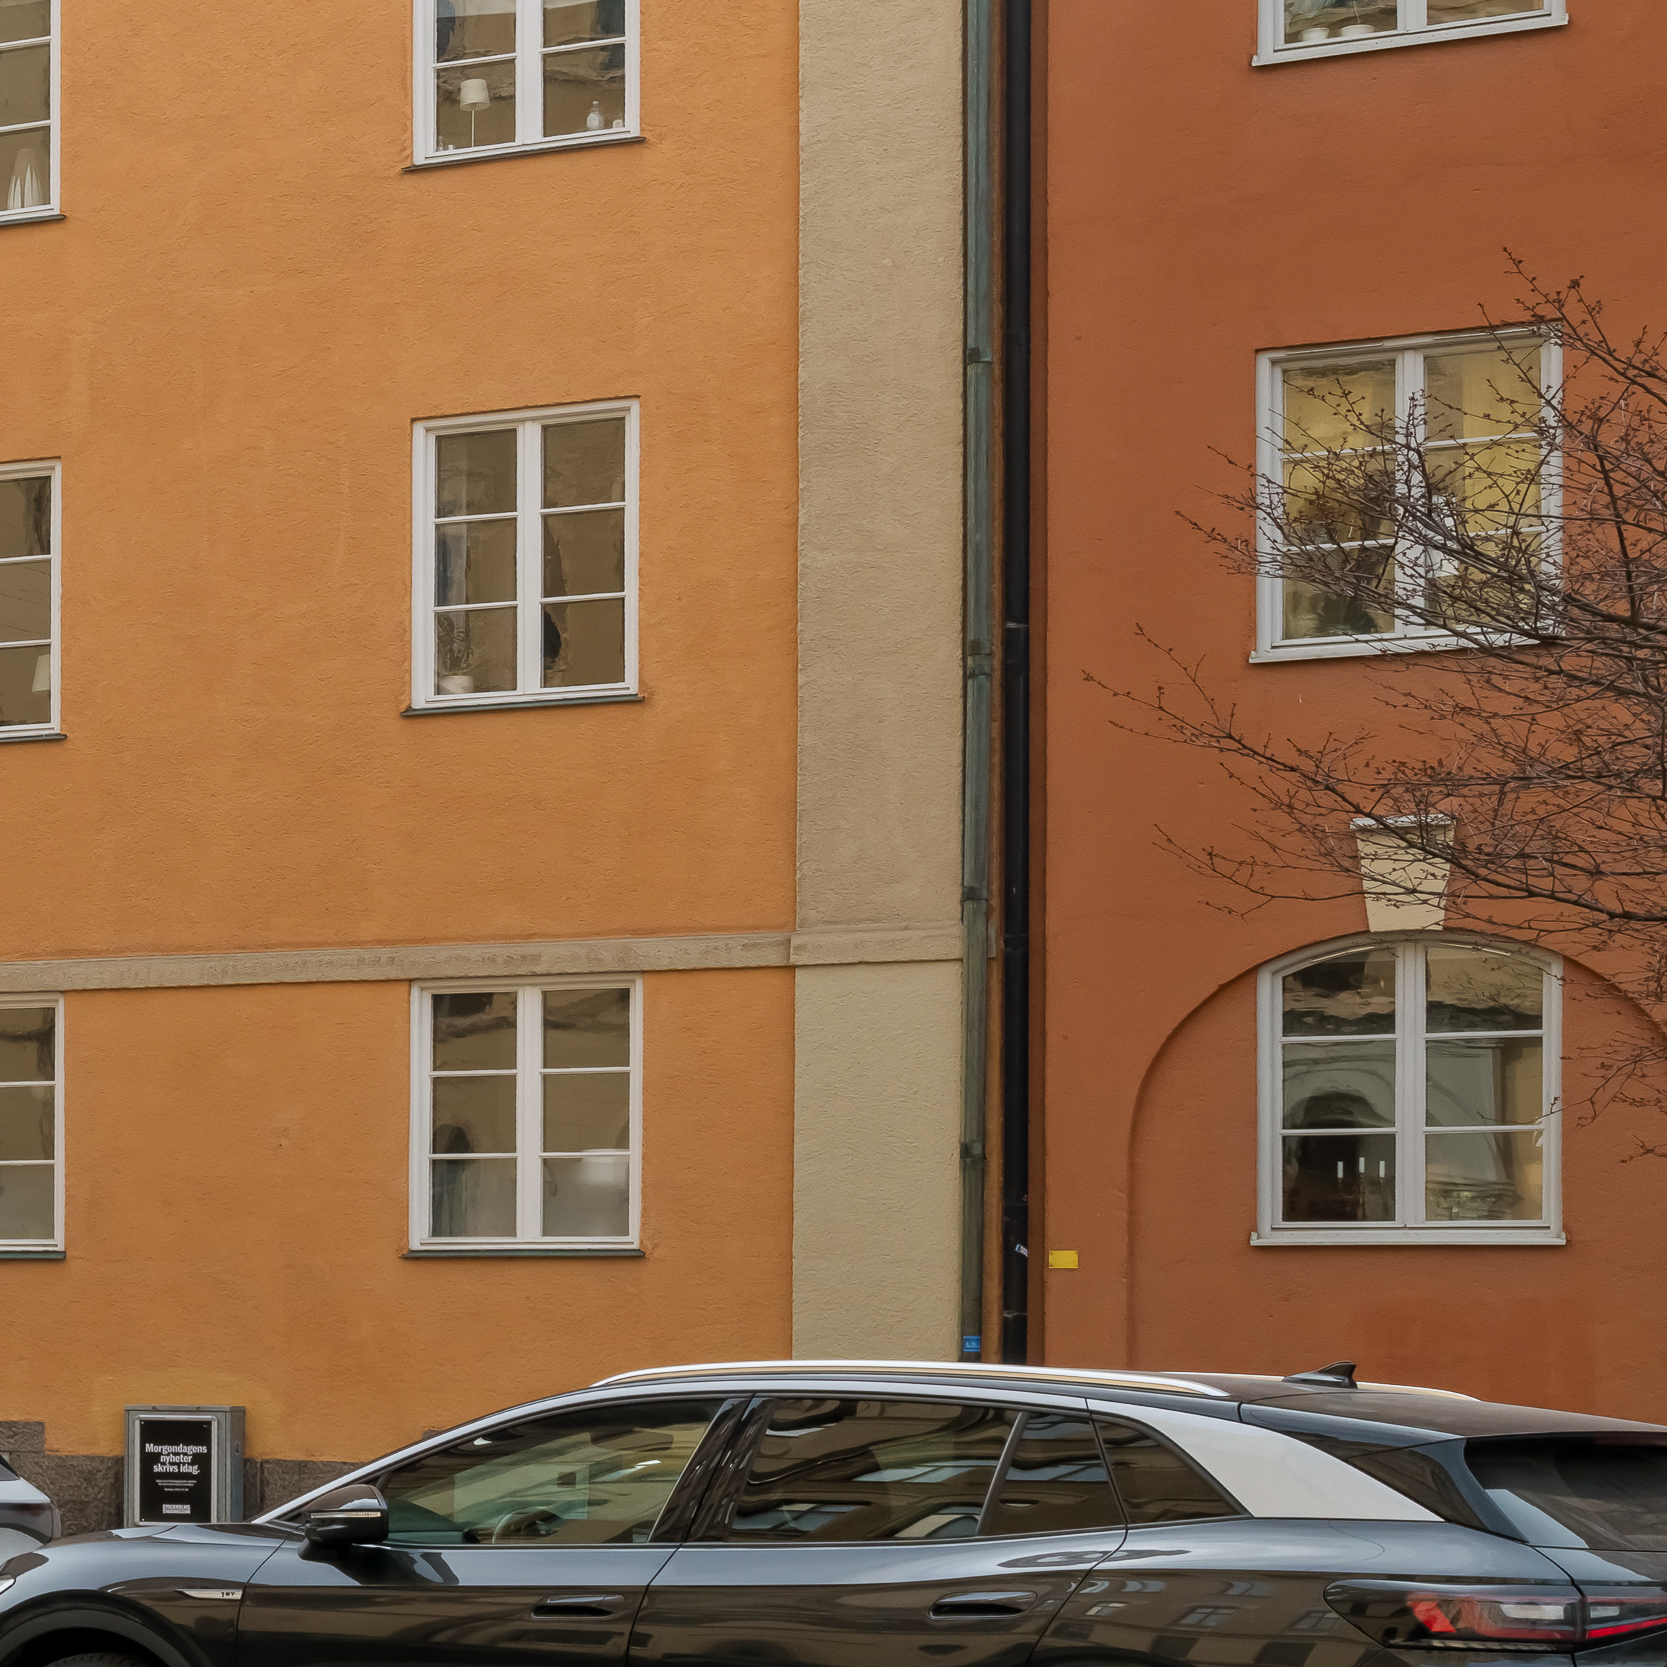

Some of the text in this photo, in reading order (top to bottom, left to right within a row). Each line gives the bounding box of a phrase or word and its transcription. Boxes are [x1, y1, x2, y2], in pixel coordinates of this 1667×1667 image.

[145, 1443, 208, 1455] Morgondagens
[160, 1453, 193, 1464] nyheter
[153, 1463, 179, 1473] skrivs
